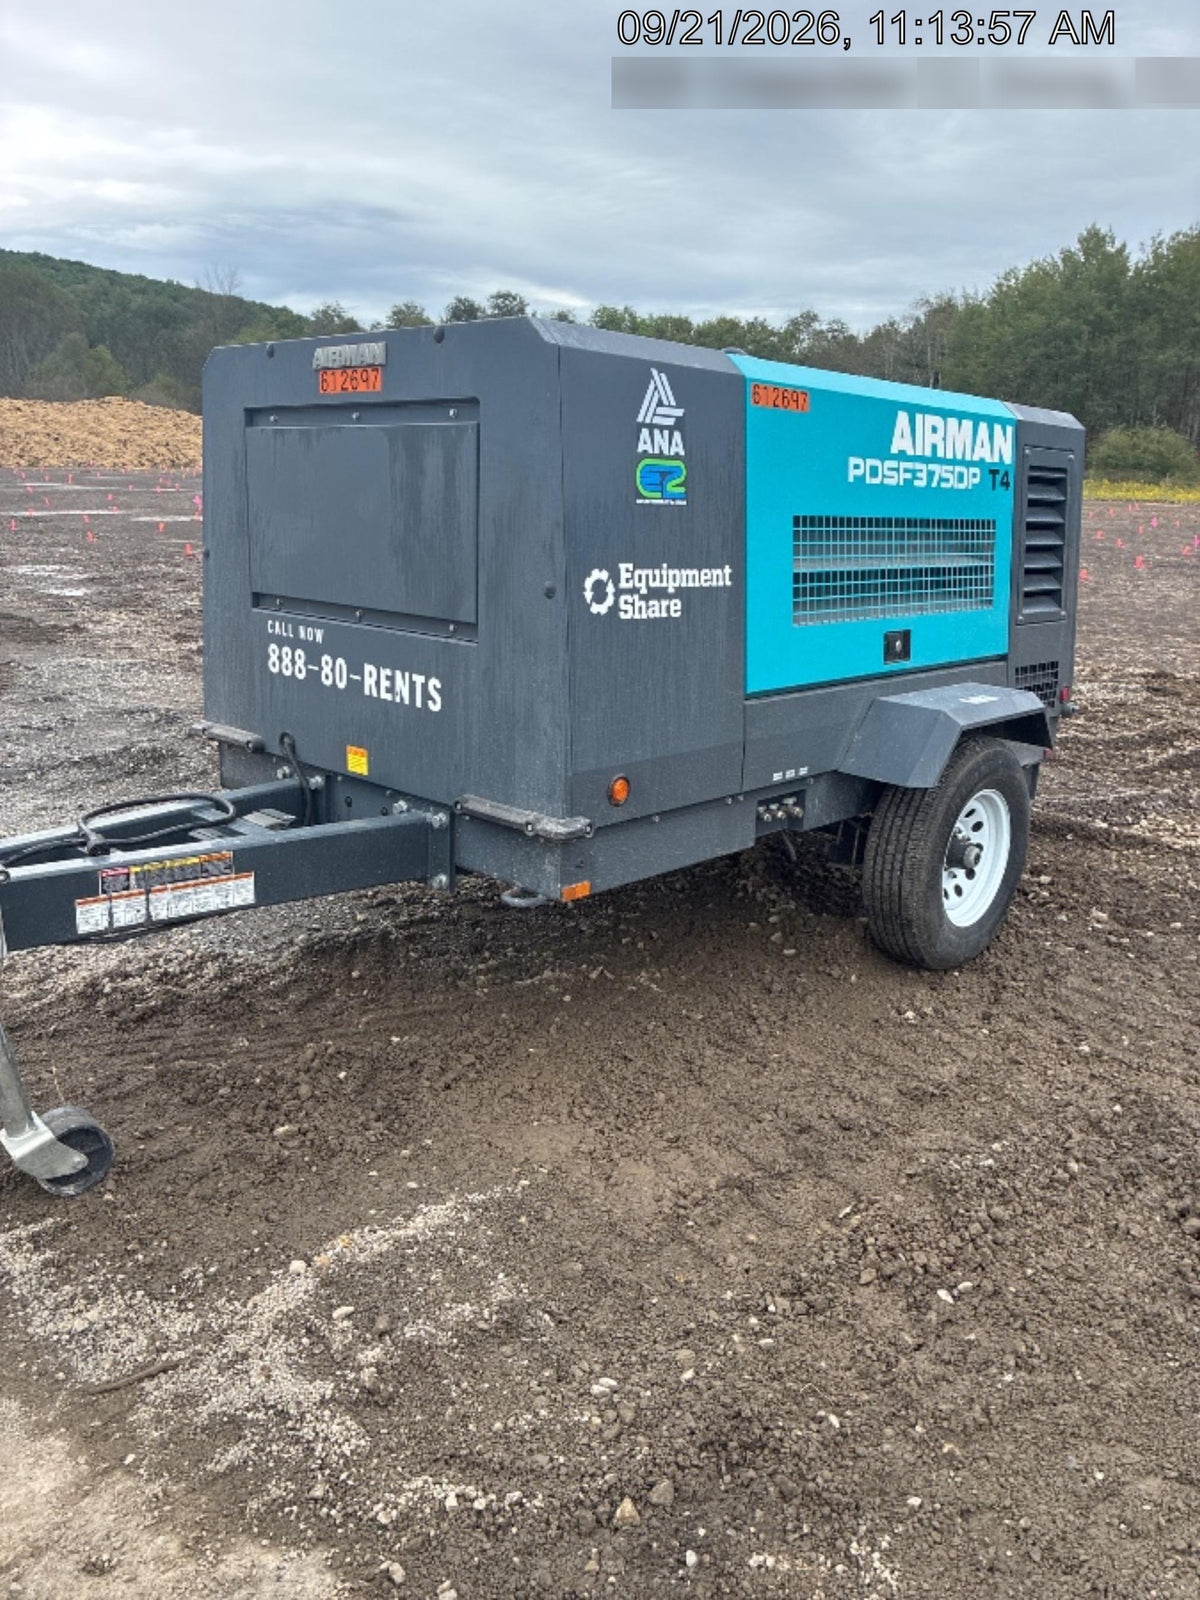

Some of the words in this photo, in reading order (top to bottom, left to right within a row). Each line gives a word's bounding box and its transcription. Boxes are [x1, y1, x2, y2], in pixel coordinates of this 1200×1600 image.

[312, 341, 387, 369] AIRMAN
[320, 367, 380, 392] 612697
[752, 383, 808, 411] 612697
[636, 427, 685, 455] ANA
[890, 410, 1013, 465] AIRMAN
[847, 456, 981, 490] PDSF375DP
[988, 469, 1011, 491] T4
[617, 562, 732, 594] Equipment
[617, 594, 682, 619] Share
[267, 620, 294, 638] CALL
[299, 625, 324, 644] NOW
[267, 643, 442, 712] 888-80-RENTS
